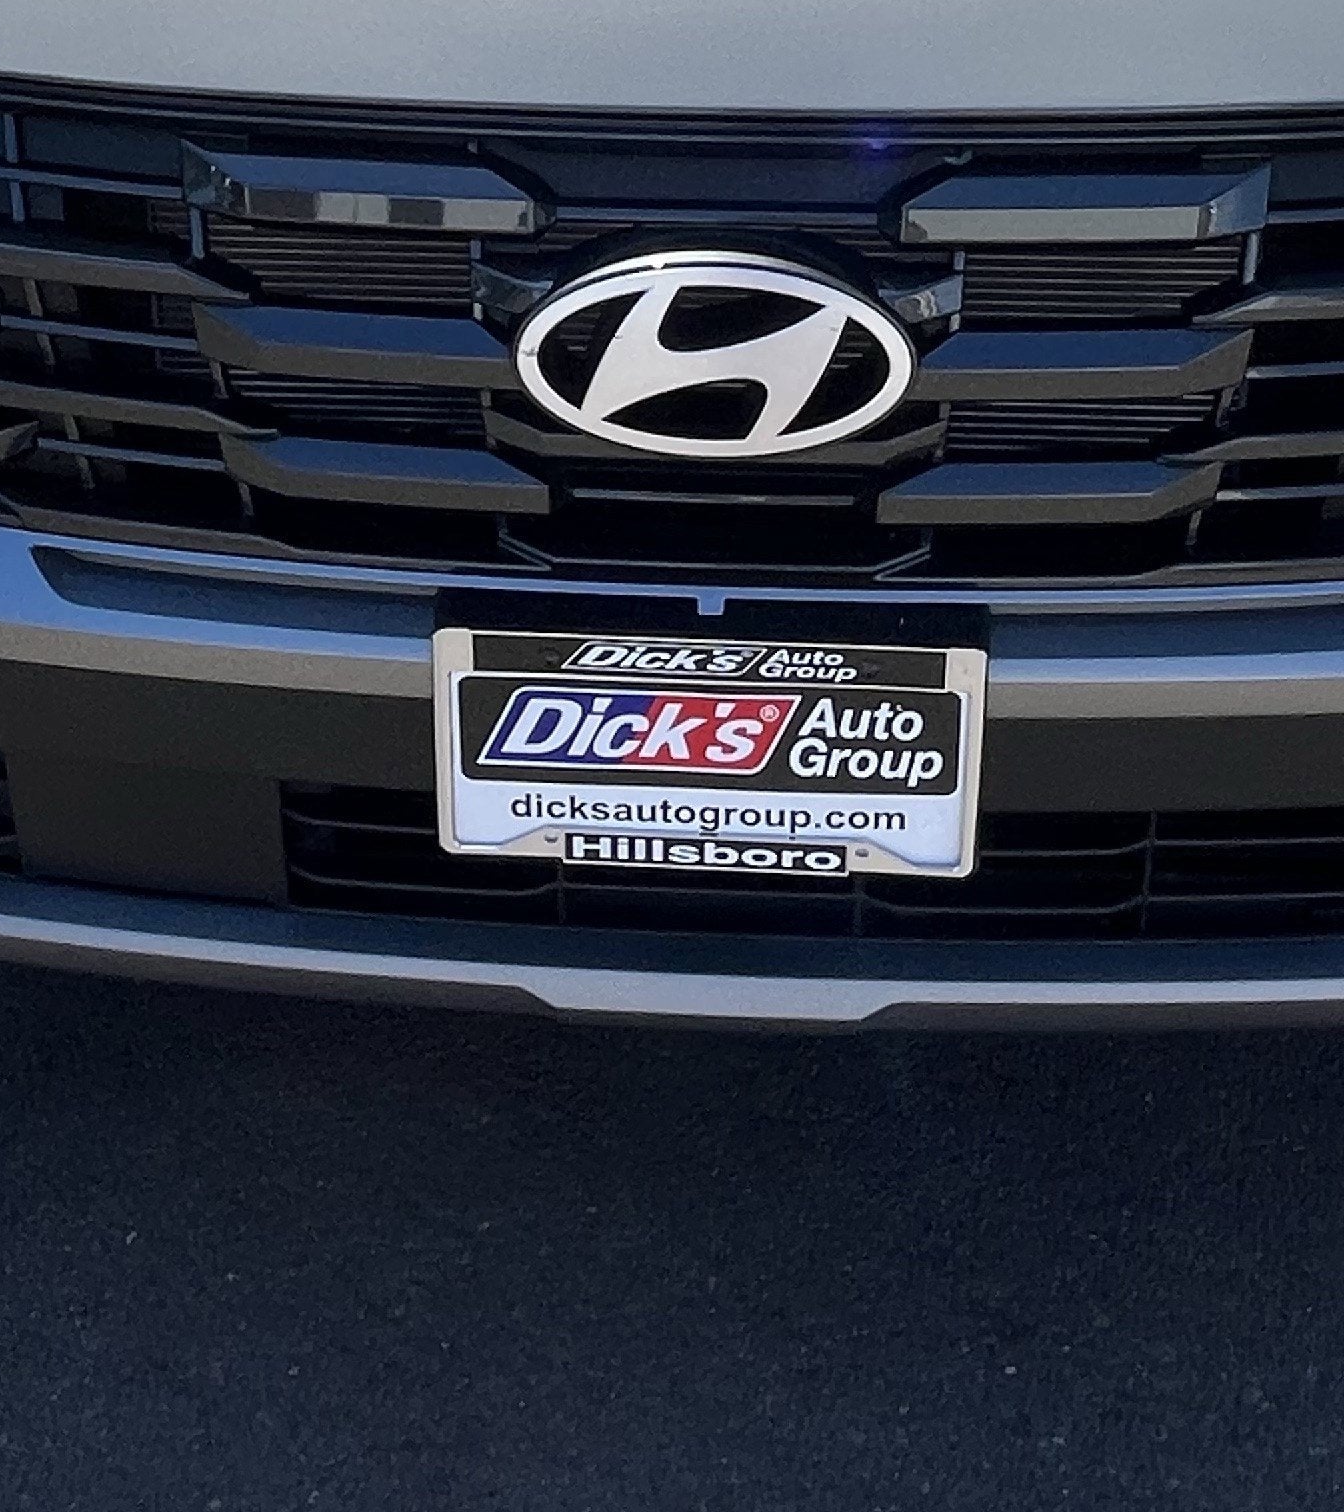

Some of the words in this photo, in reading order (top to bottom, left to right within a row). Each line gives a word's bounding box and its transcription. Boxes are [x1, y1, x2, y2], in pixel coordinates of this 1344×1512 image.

[759, 661, 858, 683] Group
[770, 648, 844, 667] Auto
[798, 698, 924, 742] Auto
[788, 738, 944, 787] Group
[509, 793, 907, 837] dicksautogroup.com
[570, 835, 843, 872] Hillsboro
